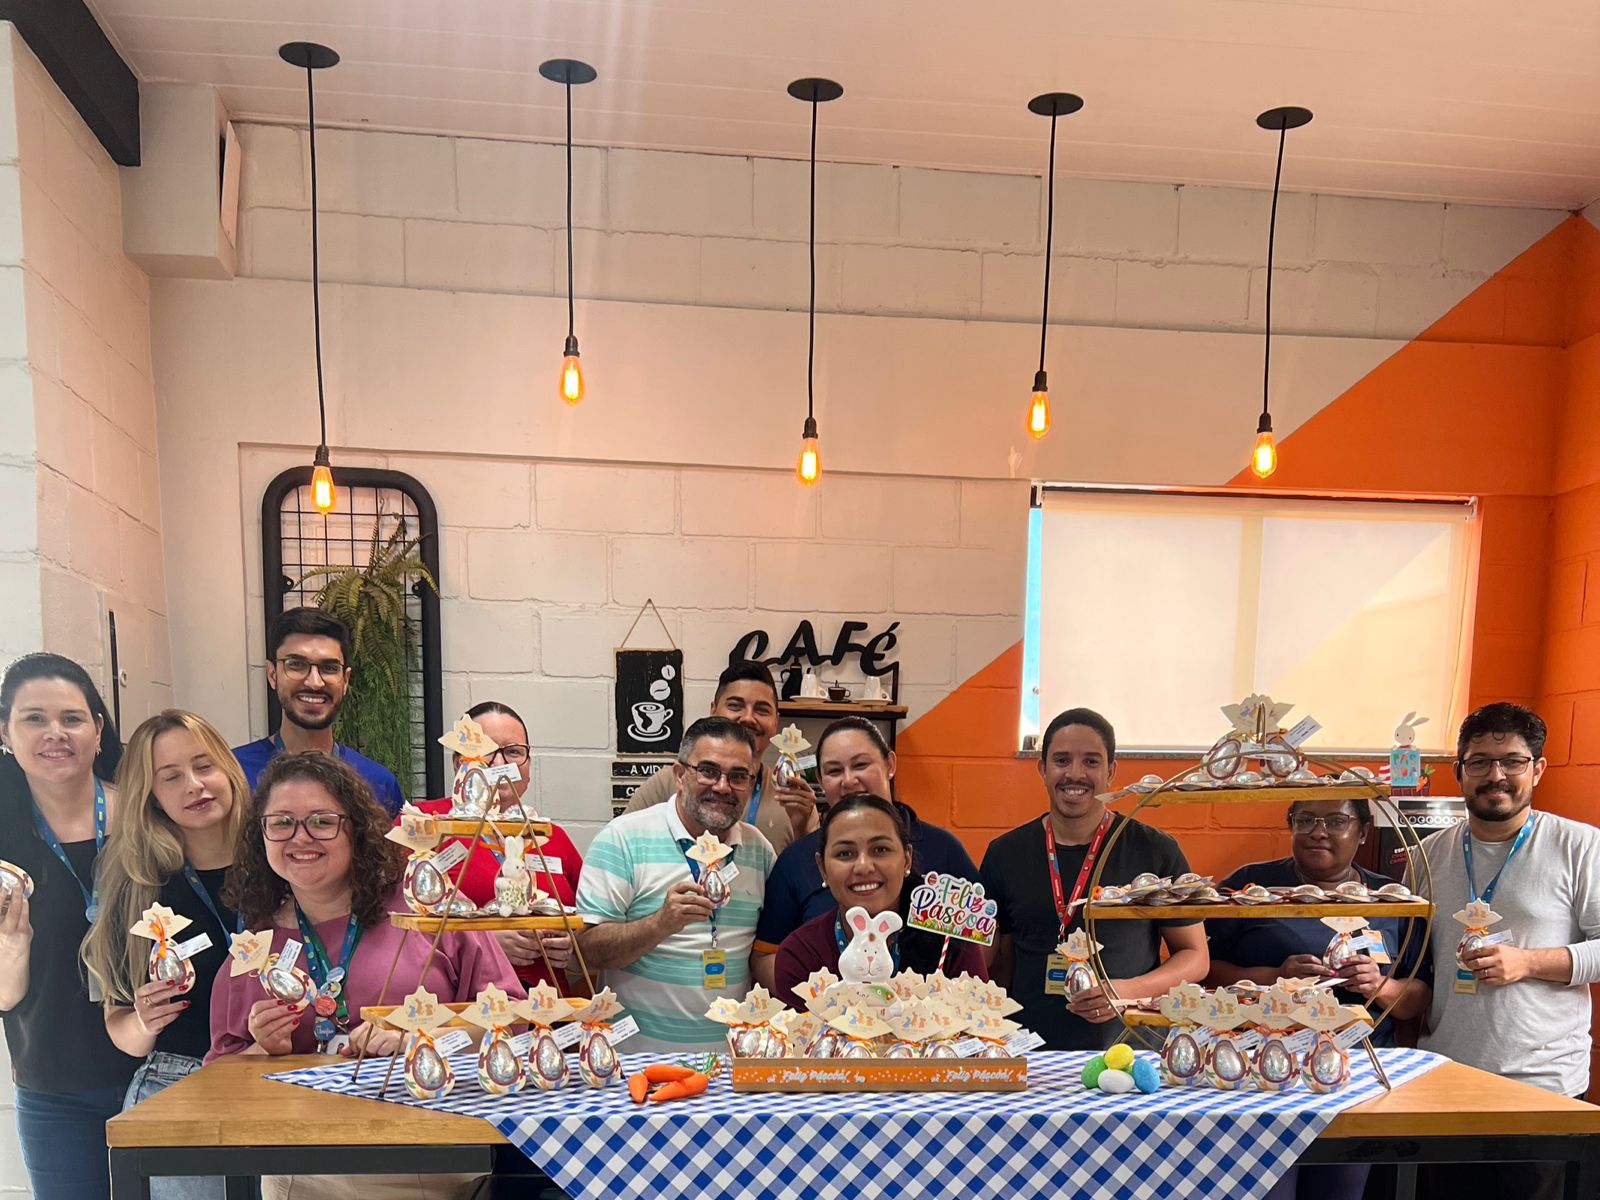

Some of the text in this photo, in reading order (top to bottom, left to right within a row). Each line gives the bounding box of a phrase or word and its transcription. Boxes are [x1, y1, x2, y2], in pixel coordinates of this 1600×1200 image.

[630, 765, 661, 775] A VID
[913, 886, 994, 932] Páscoa
[940, 877, 985, 913] Feliz
